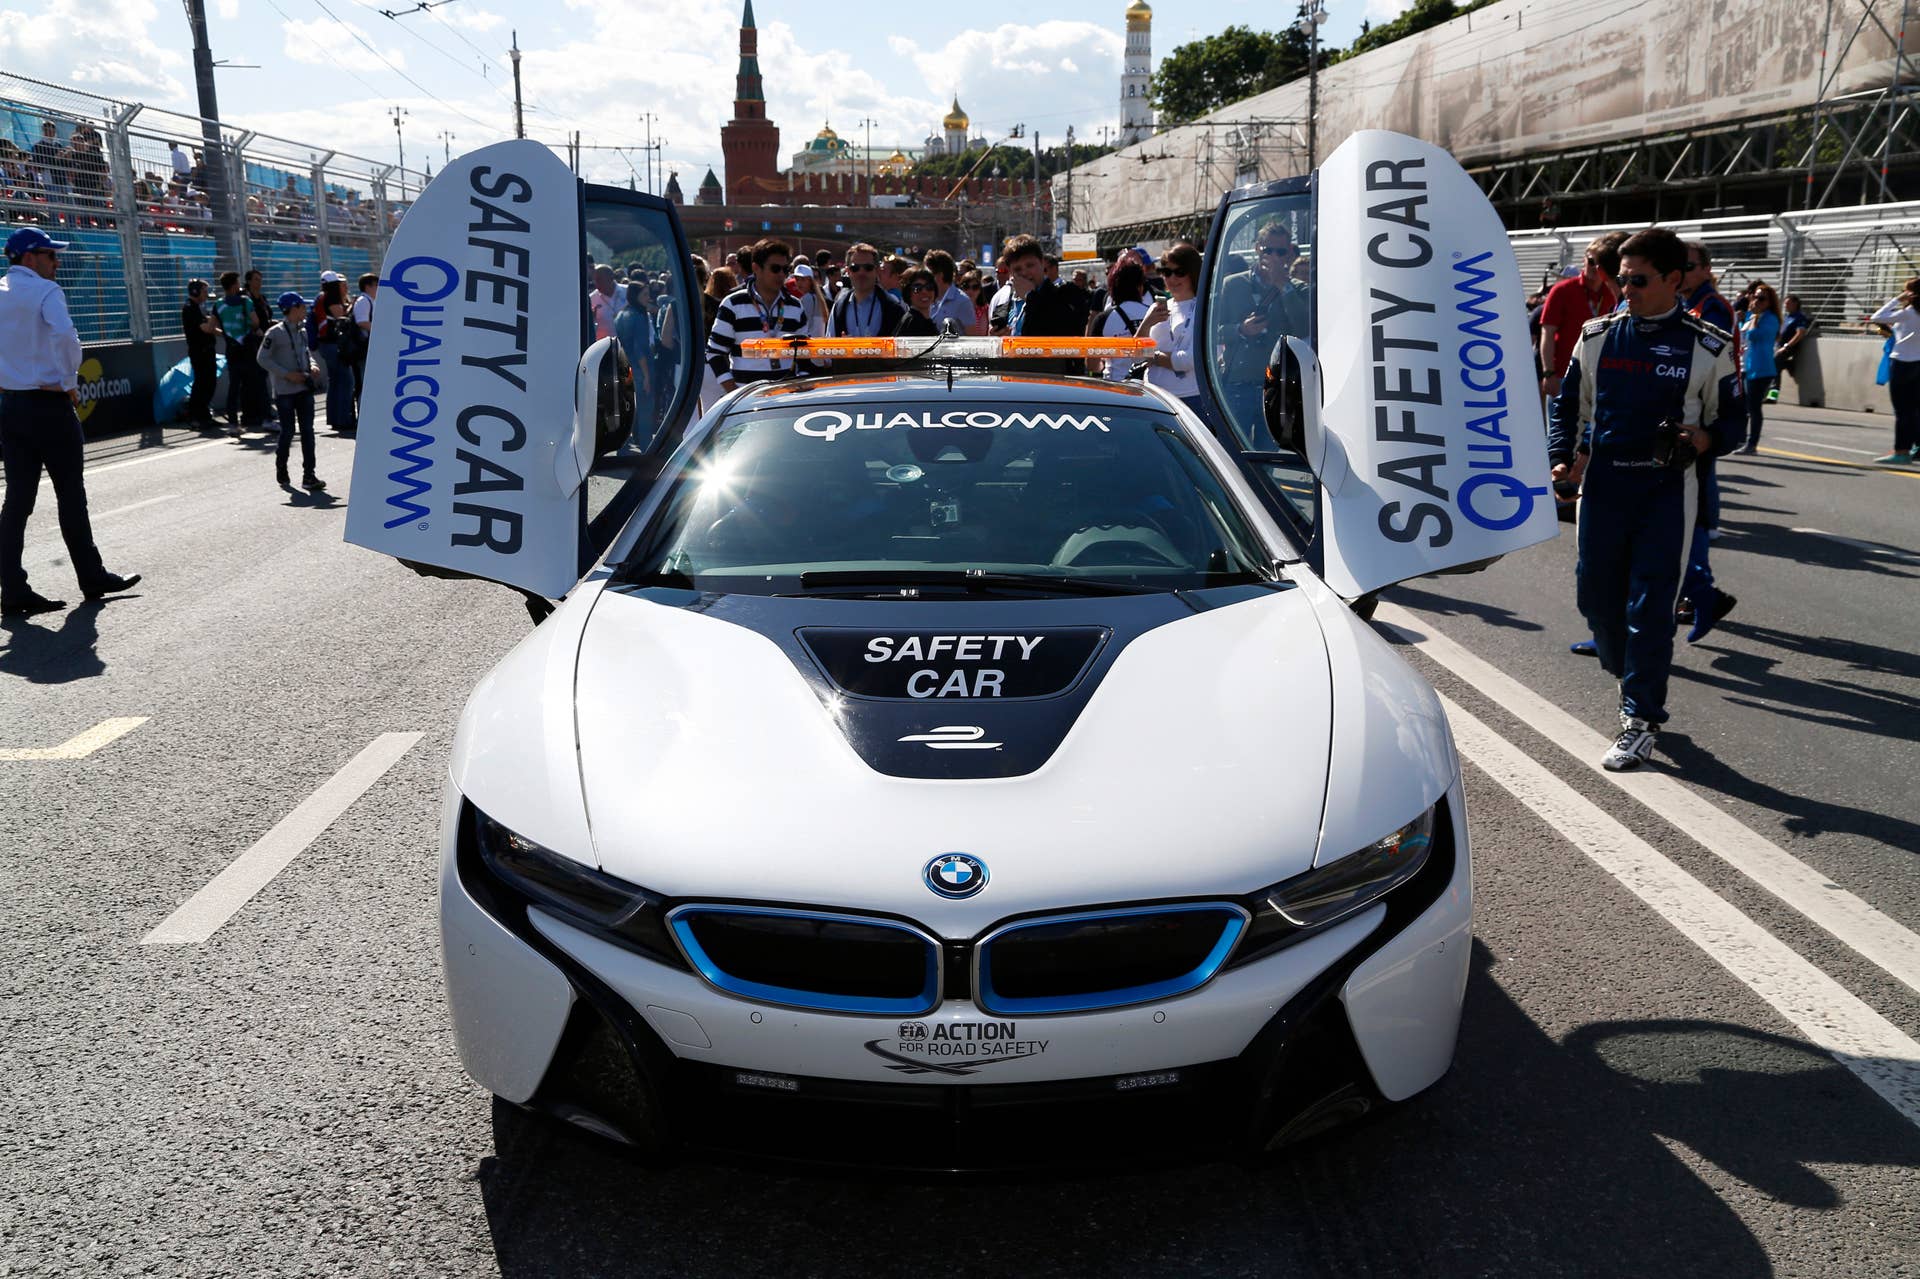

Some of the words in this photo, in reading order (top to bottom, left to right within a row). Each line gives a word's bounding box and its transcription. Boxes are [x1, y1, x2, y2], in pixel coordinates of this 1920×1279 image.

[1365, 157, 1433, 268] CAR
[461, 165, 533, 392] SAFETY
[1601, 357, 1654, 375] SAFETY
[1655, 363, 1687, 379] CAR
[1370, 287, 1453, 548] SAFETY
[451, 405, 527, 555] CAR
[864, 636, 1044, 663] SAFETY
[907, 669, 1005, 698] CAR
[936, 856, 978, 867] BMW
[933, 1022, 1016, 1041] ACTION
[899, 1043, 924, 1053] FOR
[928, 1043, 977, 1056] ROAD
[981, 1040, 1050, 1056] SAFETY
